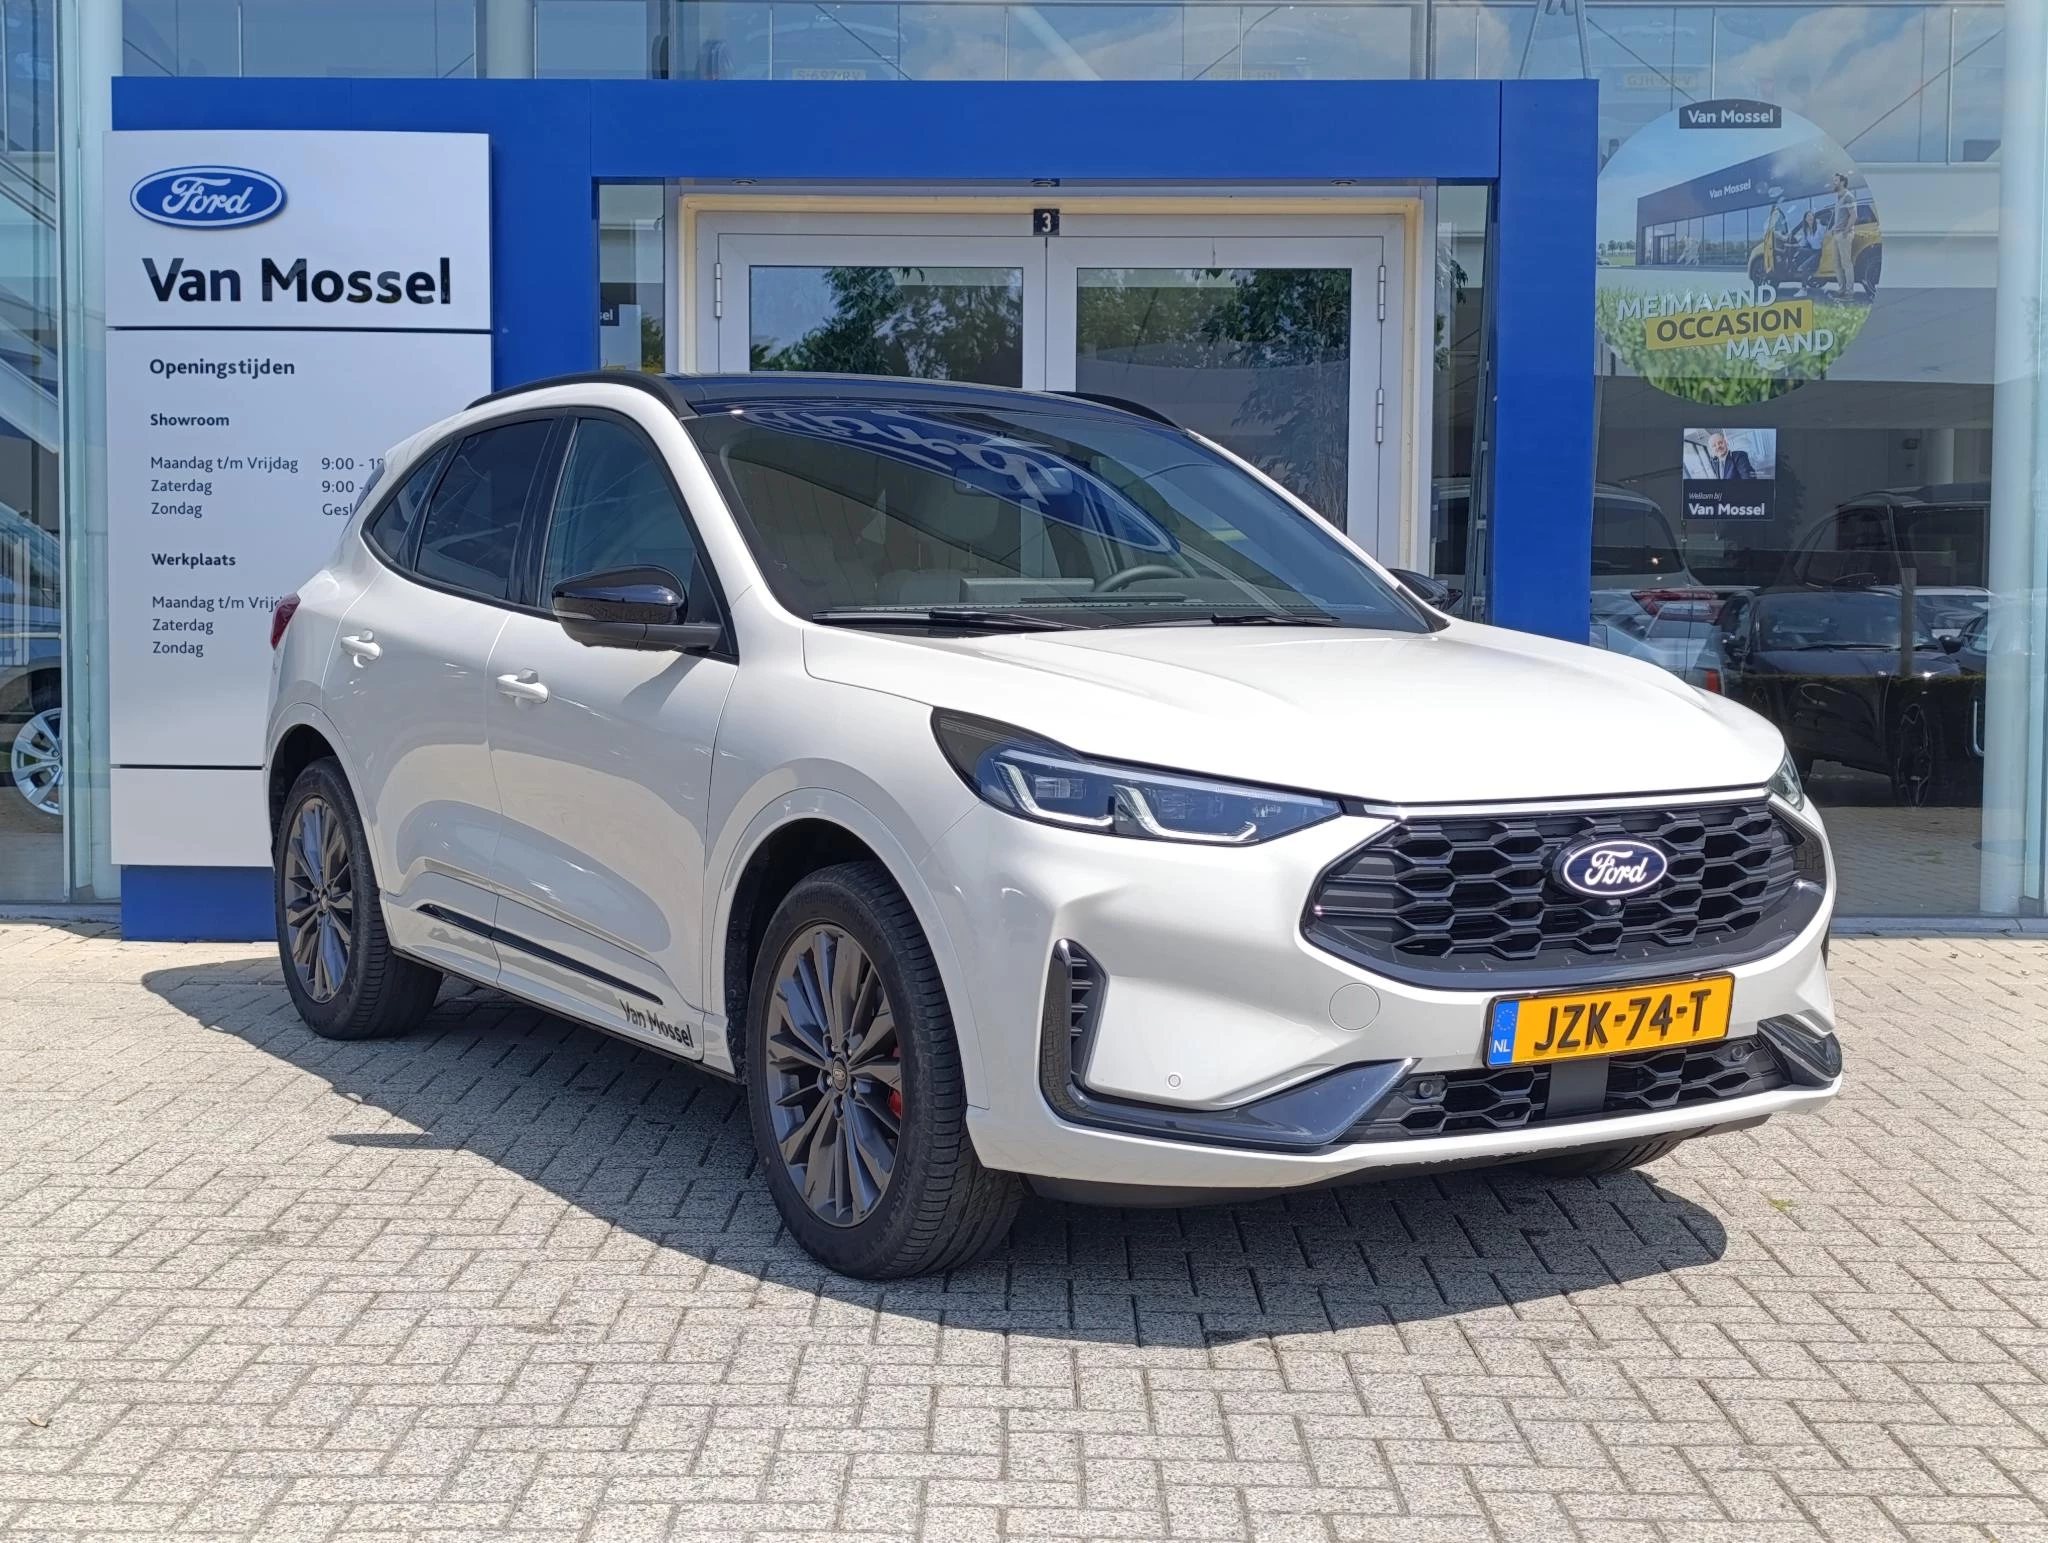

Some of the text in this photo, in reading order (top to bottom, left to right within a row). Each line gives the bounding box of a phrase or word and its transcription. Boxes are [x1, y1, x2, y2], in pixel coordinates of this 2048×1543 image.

[1688, 108, 1774, 123] Van Mossel
[162, 176, 254, 215] Ford
[1709, 178, 1752, 199] Van Mossel
[1042, 212, 1052, 233] 3
[142, 257, 451, 304] Van Mossel
[1617, 283, 1777, 321] MEIMAAND
[1656, 307, 1802, 342] OCCASION
[1726, 329, 1834, 360] MAAND
[149, 359, 296, 379] Openingstijden
[149, 413, 230, 427] Showroom
[150, 456, 213, 472] Maandag
[216, 456, 243, 470] t/m
[247, 456, 299, 473] Vrijdag
[321, 457, 355, 470] 9:00
[151, 479, 213, 495] Zaterdag
[321, 480, 355, 493] 9:00
[1688, 491, 1723, 501] Welkom bij
[151, 502, 202, 518] Zondag
[1688, 502, 1765, 516] Van Mossel
[152, 553, 236, 569] Werkplaats
[152, 596, 215, 612] Maandag
[218, 595, 244, 609] t/m
[152, 618, 214, 635] Zaterdag
[153, 641, 204, 657] Zondag
[1584, 849, 1649, 886] Ford
[618, 998, 694, 1049] Van Mossel
[1493, 988, 1712, 1053] NL JZK-74-T
